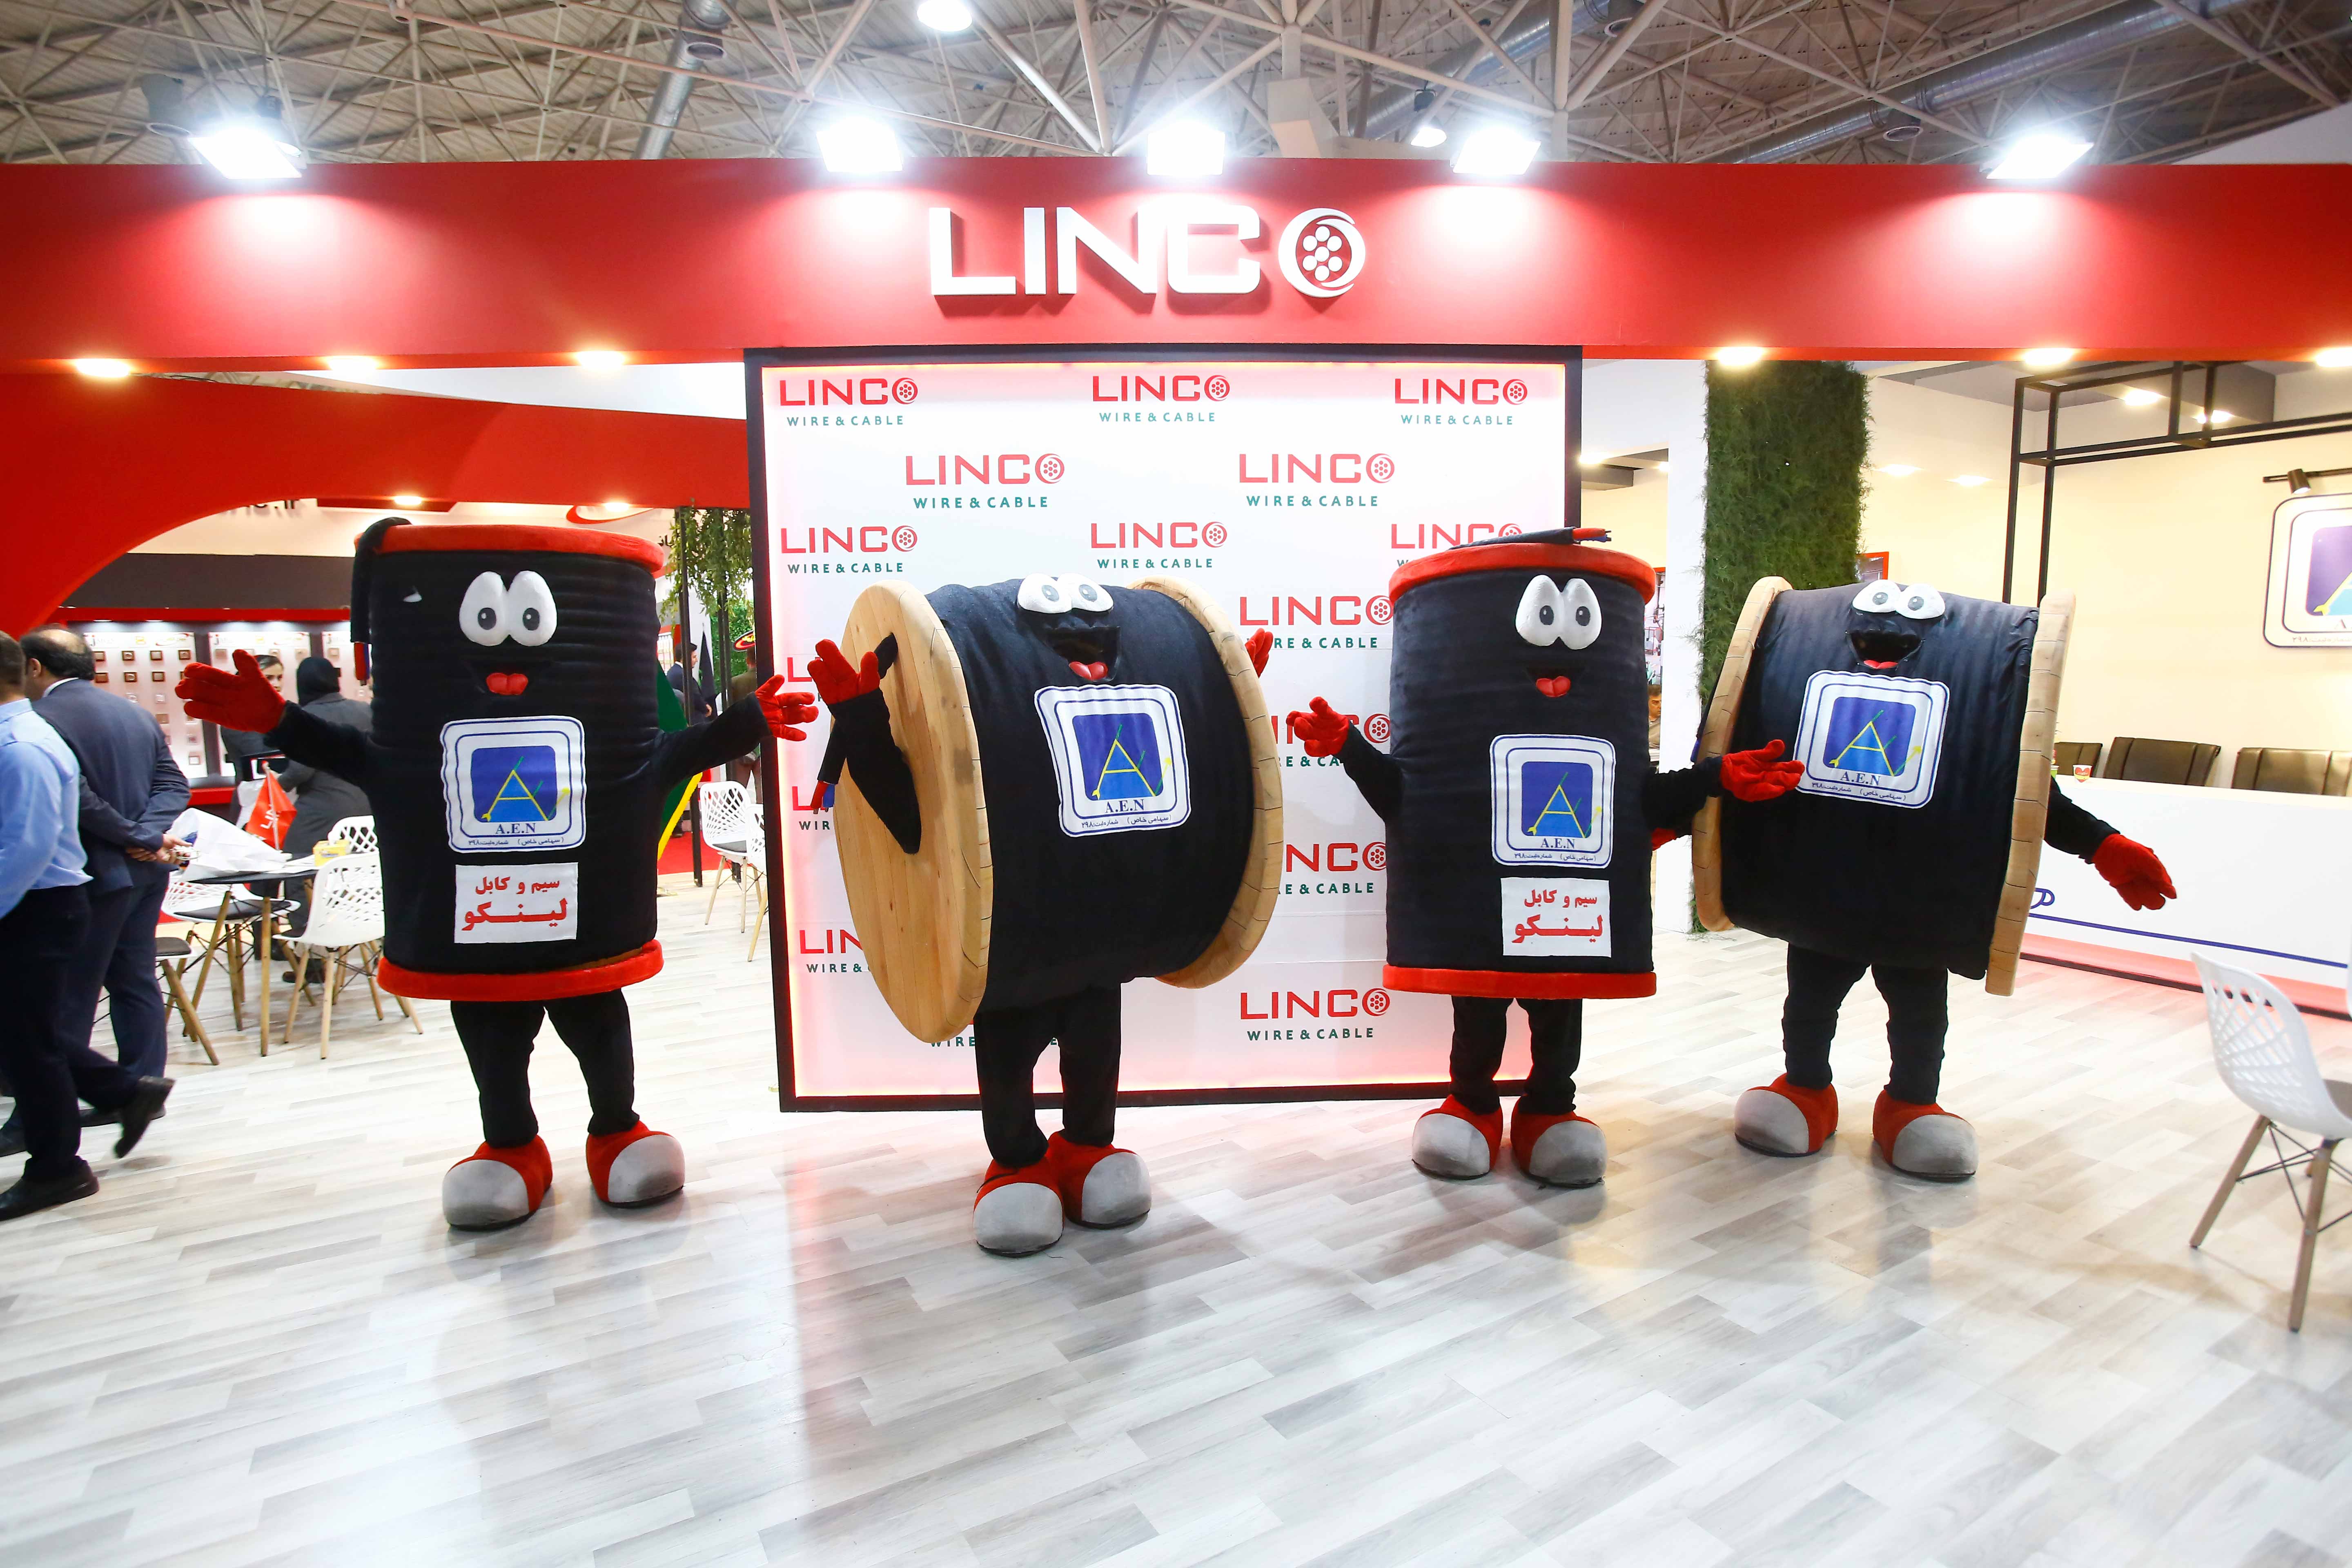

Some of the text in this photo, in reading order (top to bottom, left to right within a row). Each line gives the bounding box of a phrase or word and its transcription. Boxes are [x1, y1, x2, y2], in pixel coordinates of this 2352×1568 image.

[929, 205, 1366, 298] LINCO
[780, 378, 918, 406] LINCO
[1093, 374, 1230, 402] LINCO
[1395, 378, 1528, 405] LINCO
[787, 415, 903, 426] WIRE & CABLE
[1099, 412, 1215, 422] WIRE & CABLE
[1401, 415, 1513, 425] WIRE & CABLE
[906, 453, 1065, 486] LINCO
[1239, 453, 1394, 483] LINCO
[913, 496, 1048, 509] WIRE & CABLE
[1246, 495, 1378, 507] WIRE & CABLE
[781, 526, 918, 554] LINCO
[1091, 521, 1227, 548] LINCO
[787, 563, 903, 574] WIRE & CABLE
[1097, 558, 1212, 569] WIRE & CABLE
[1240, 595, 1393, 626] LINCO
[1302, 637, 1313, 648] &
[1319, 637, 1378, 648] CABLE
[1840, 771, 1881, 786] A.E.N
[1105, 799, 1145, 813] A.E.N
[495, 823, 536, 834] A.E.N
[1540, 837, 1575, 849] A.E.N
[476, 876, 559, 895] سیم و کابل
[1316, 882, 1374, 894] CABLE
[1524, 889, 1597, 908] سیم و کابل
[806, 963, 847, 973] WIRE
[1241, 988, 1390, 1020] LINCO
[1247, 1028, 1373, 1041] WIRE & CABLE
